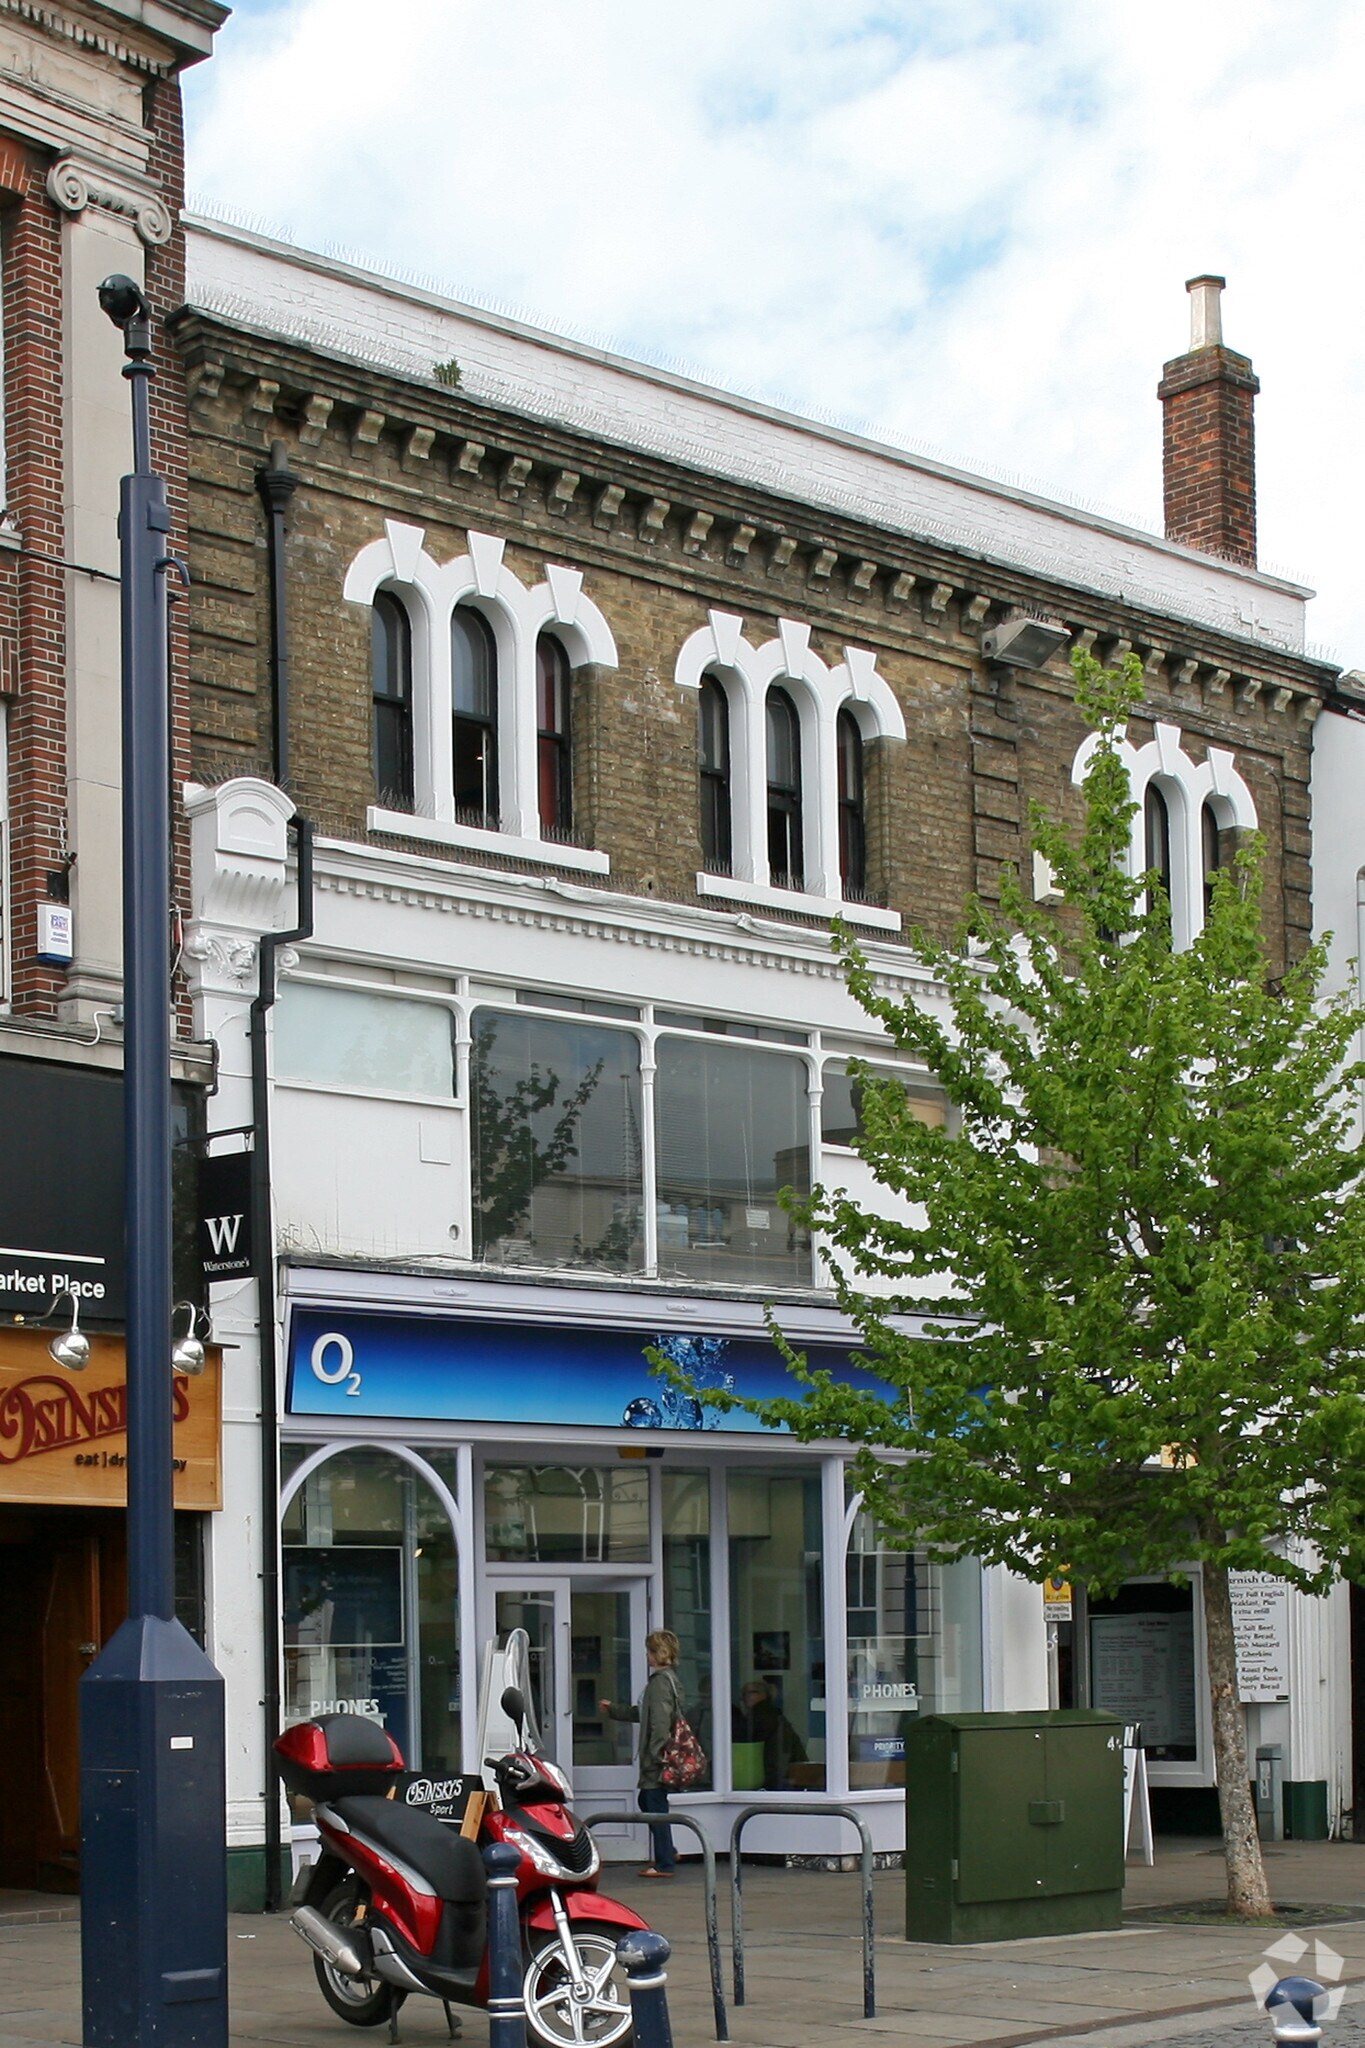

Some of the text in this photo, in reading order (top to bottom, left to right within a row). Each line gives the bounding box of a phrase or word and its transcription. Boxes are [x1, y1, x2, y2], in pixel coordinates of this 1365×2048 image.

[204, 1214, 244, 1255] W
[0, 1269, 106, 1299] arket Place
[75, 1453, 99, 1467] eat
[863, 1683, 916, 1698] PHONES
[310, 1698, 380, 1717] PHONES
[429, 1802, 454, 1816] Sport
